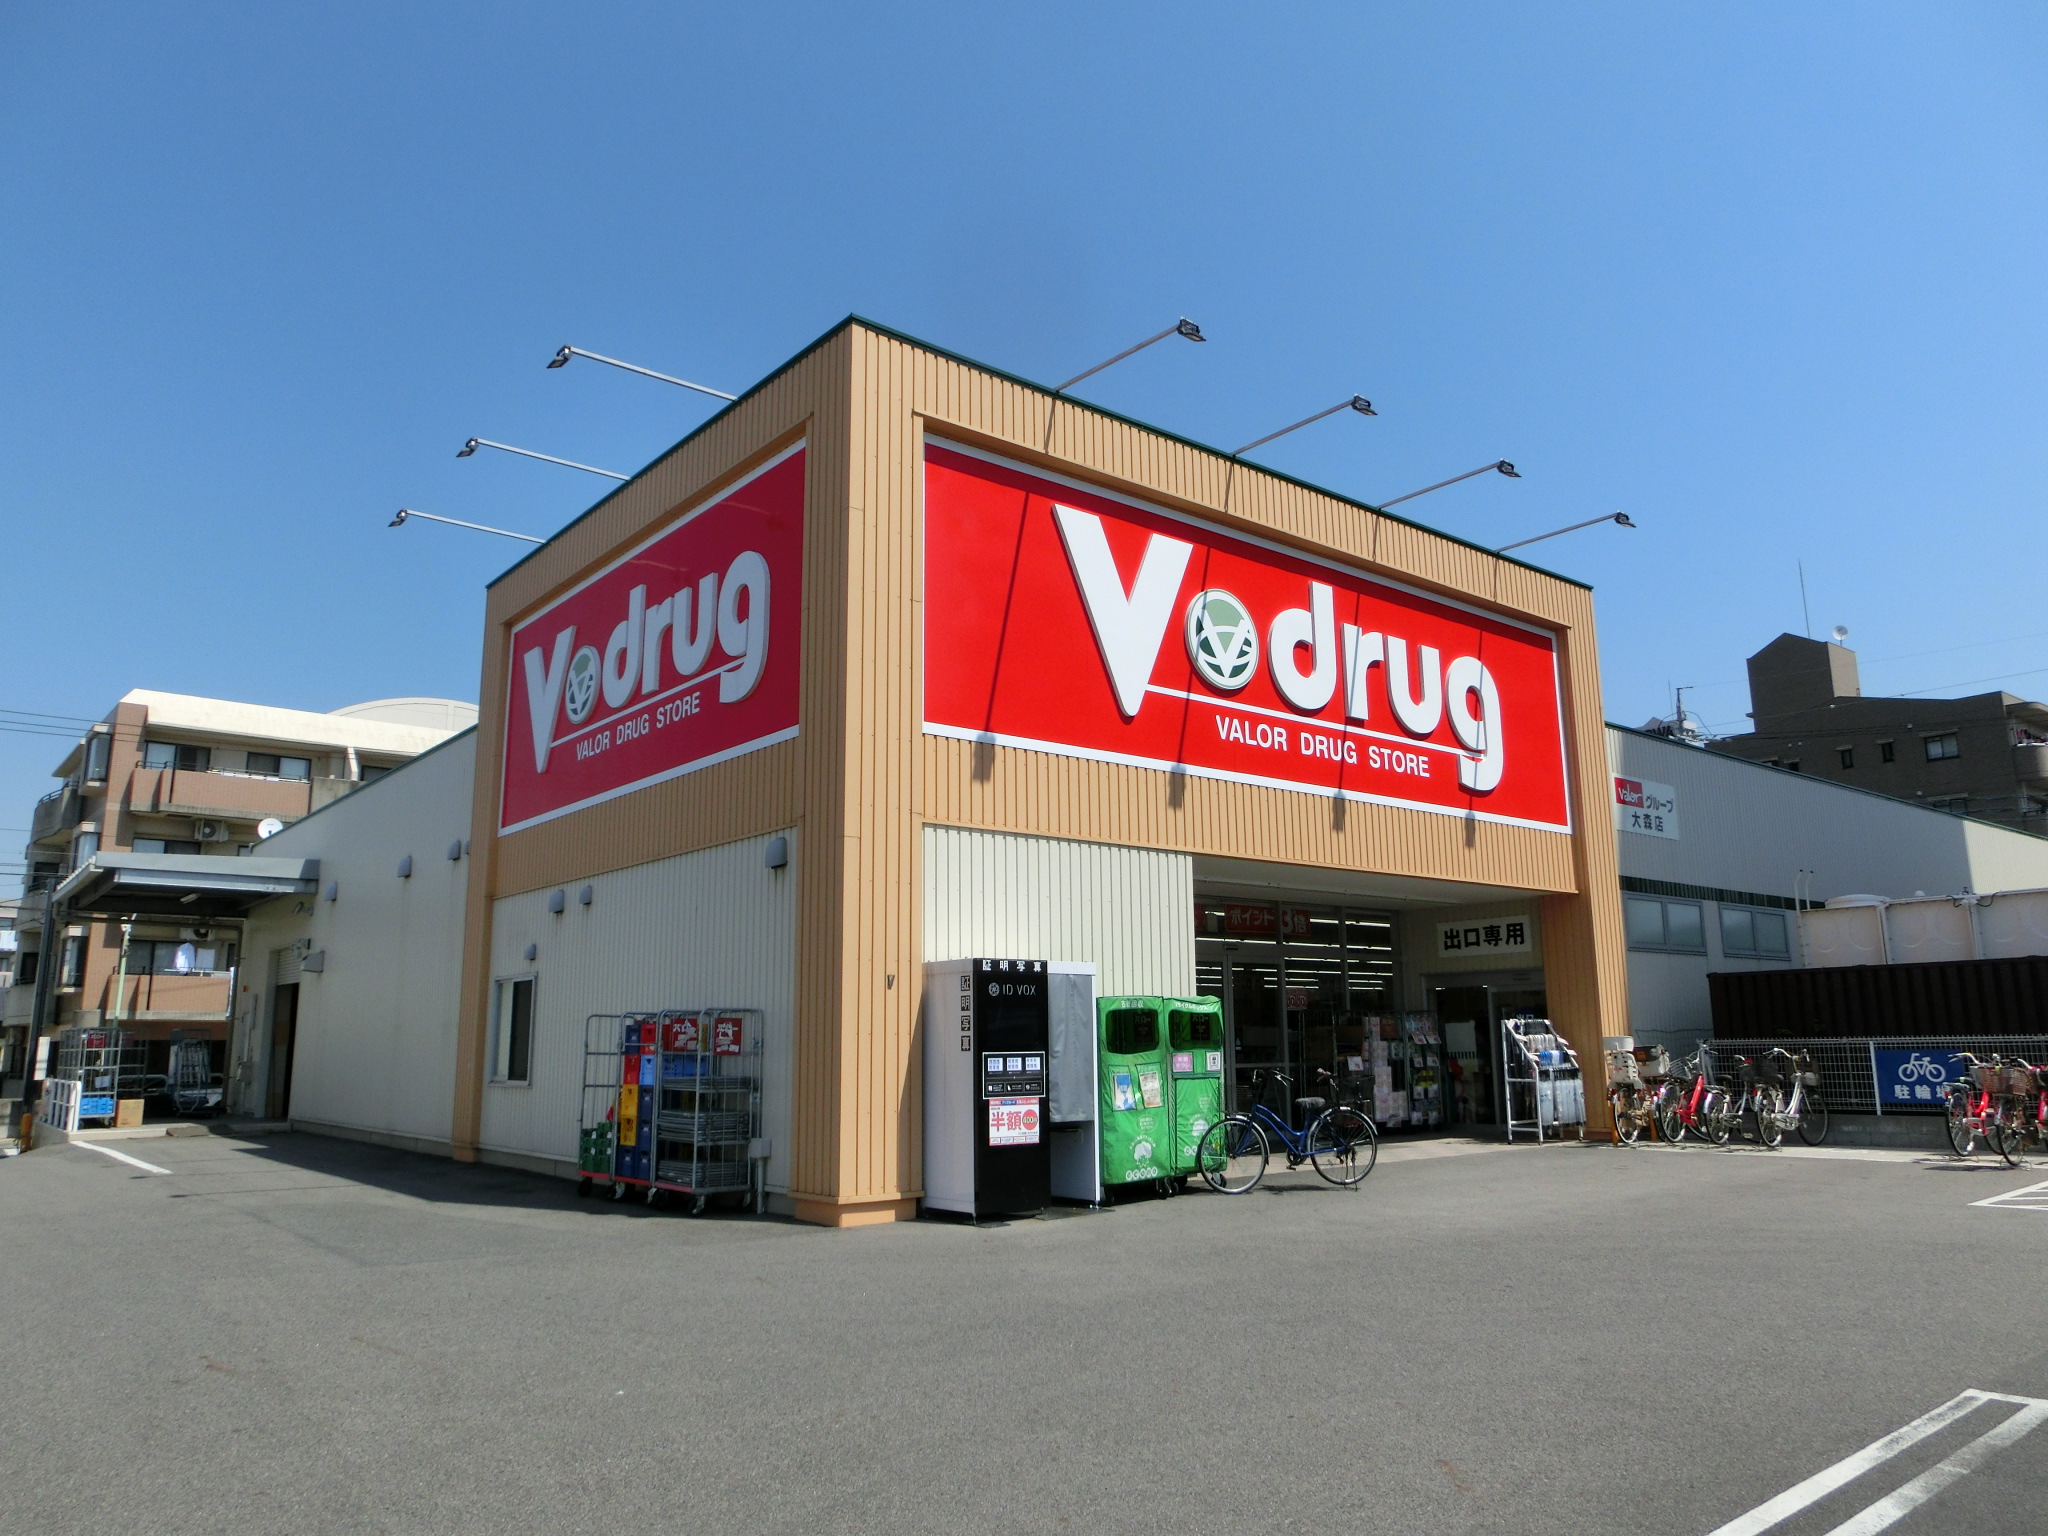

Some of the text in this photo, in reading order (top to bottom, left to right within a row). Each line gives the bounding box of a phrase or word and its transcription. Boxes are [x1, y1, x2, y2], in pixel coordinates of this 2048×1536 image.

[576, 694, 700, 760] VALOR DRUG STORE
[1216, 715, 1430, 777] VALOR DRUG STORE
[1646, 794, 1674, 813] グループ
[1632, 811, 1664, 832] 大森店
[1443, 922, 1525, 950] 出口専用
[982, 959, 1042, 972] 証明写真
[1002, 984, 1036, 996] ID VOX
[961, 974, 970, 1052] 証明写真
[991, 1111, 1022, 1132] 半額
